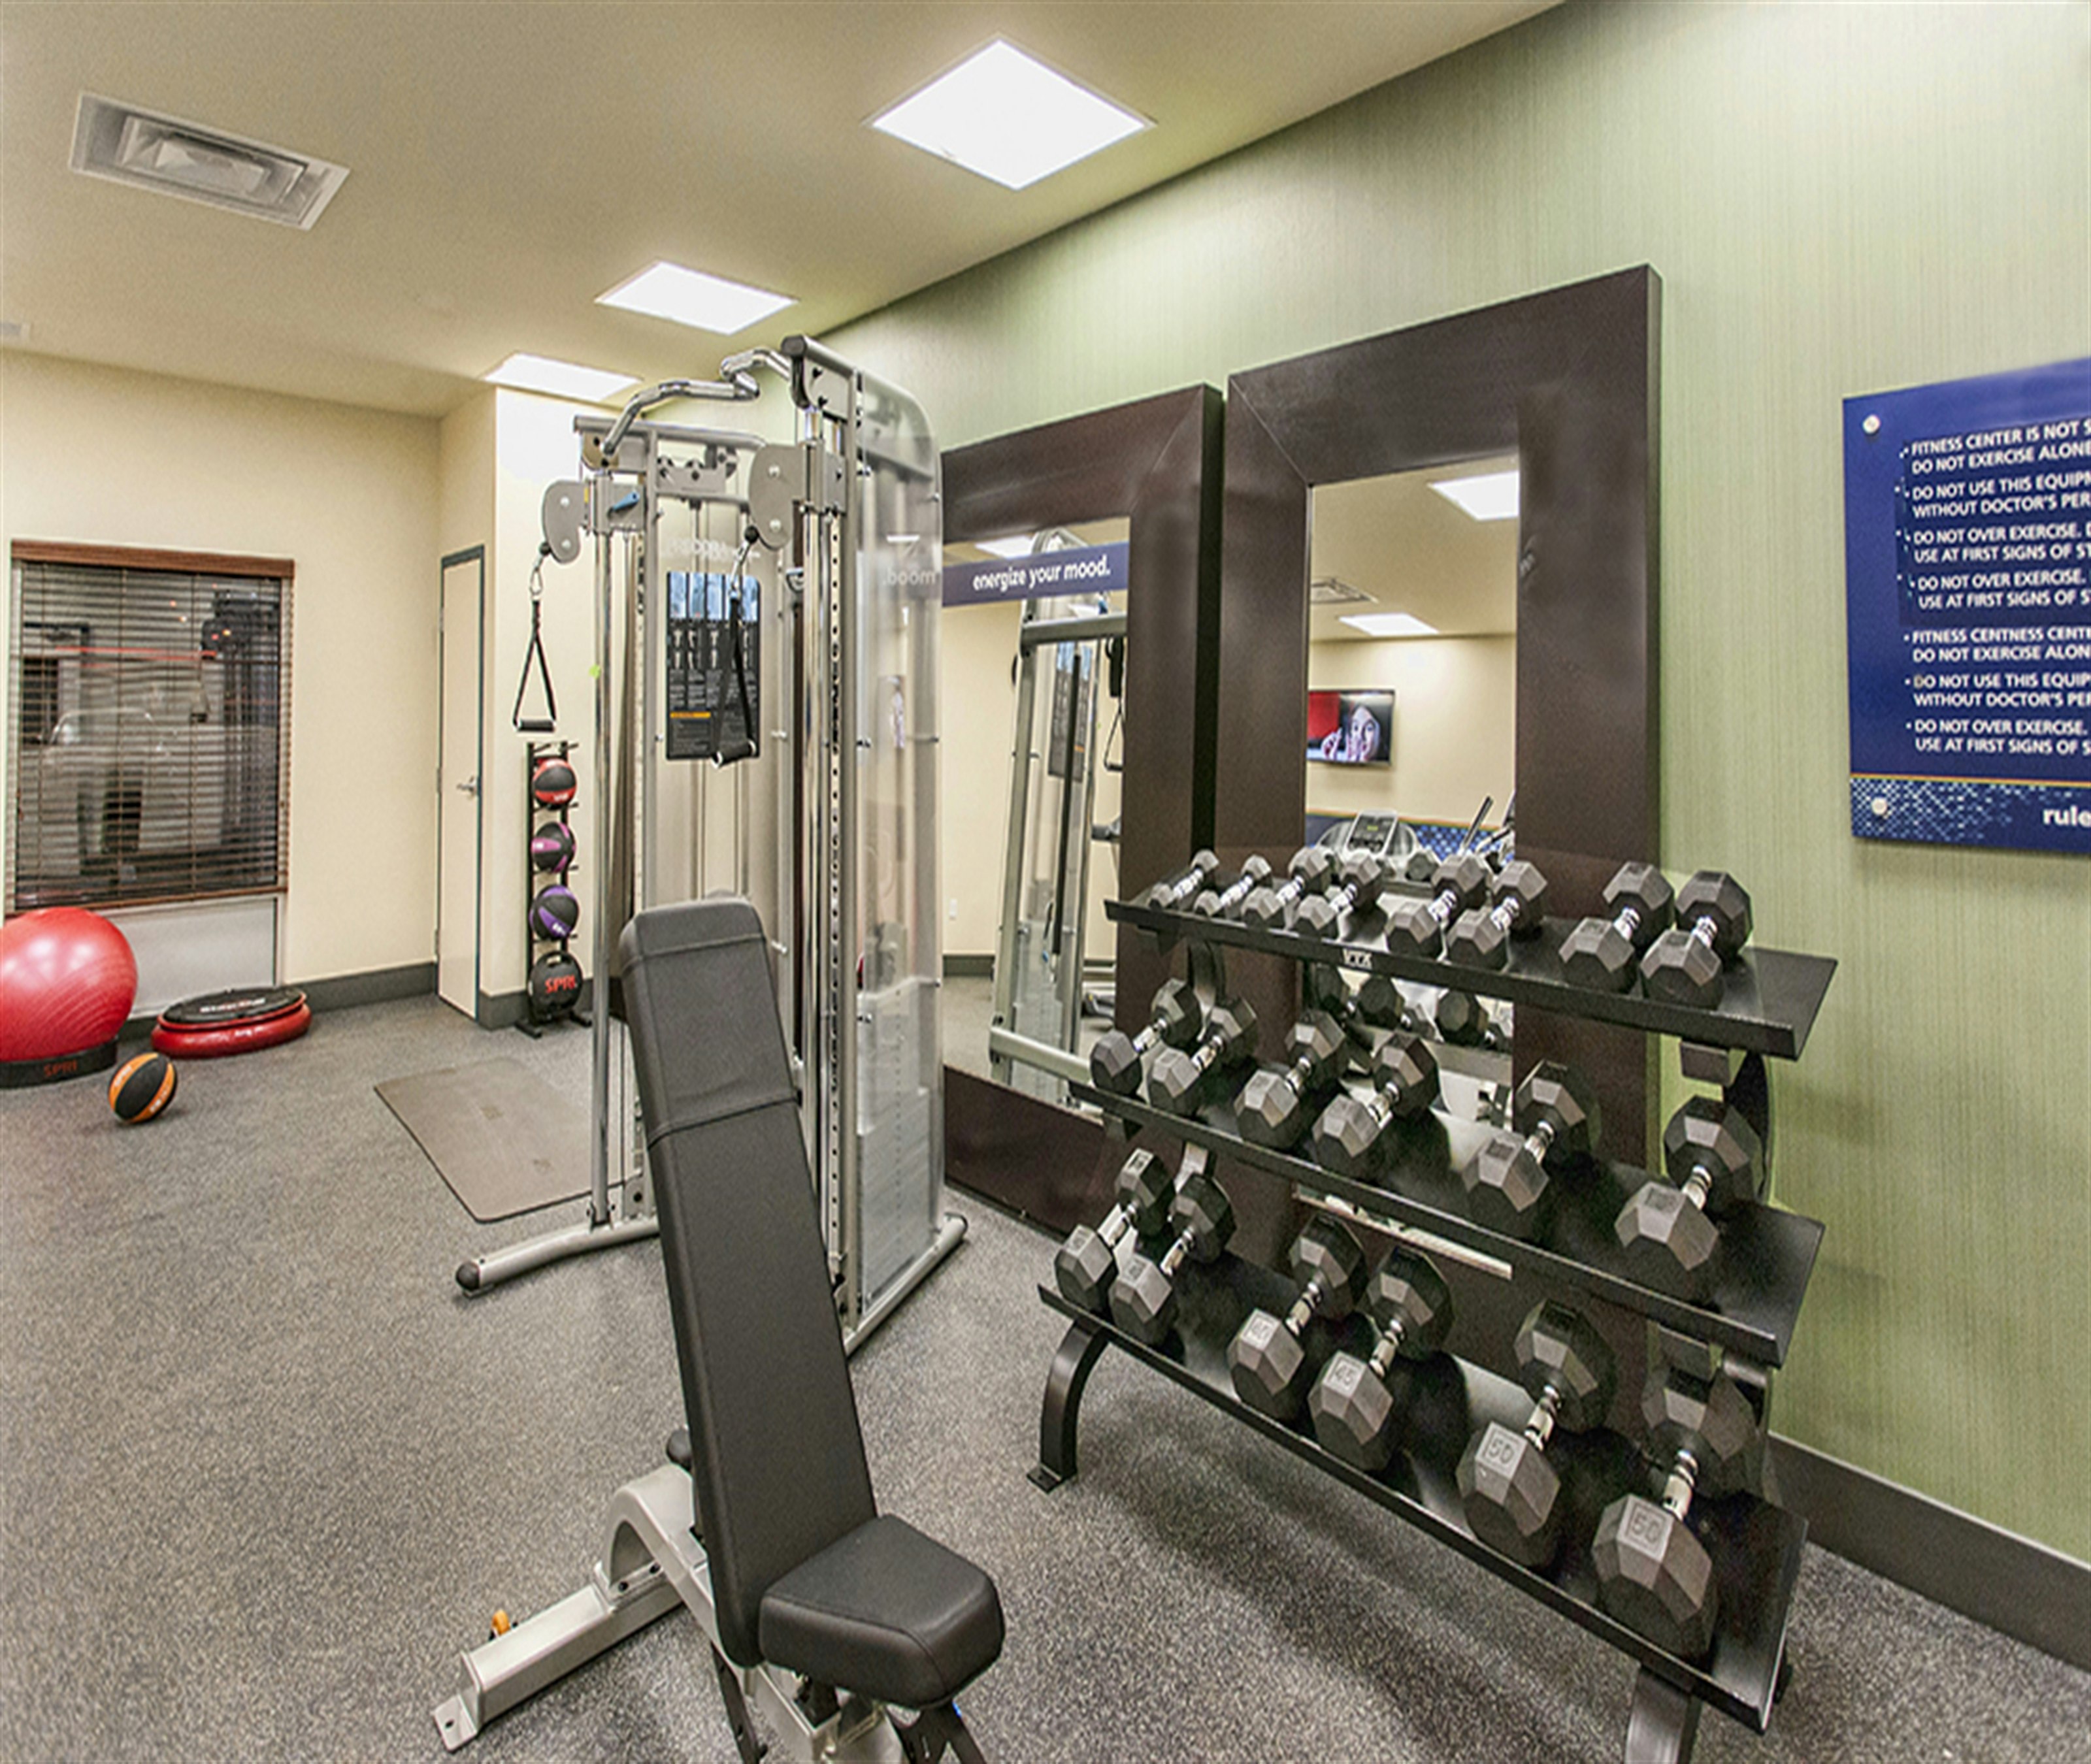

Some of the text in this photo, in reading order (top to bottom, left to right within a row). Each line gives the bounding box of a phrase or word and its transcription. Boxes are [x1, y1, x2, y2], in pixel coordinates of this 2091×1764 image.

[1912, 438, 1962, 456] FITNESS
[1966, 430, 2022, 448] CENTER
[2026, 427, 2039, 441] IS
[2044, 420, 2079, 439] NOT
[1912, 459, 1934, 474] DO
[1936, 455, 1965, 471] NOT
[1968, 448, 2033, 467] EXERCISE
[1913, 485, 1934, 500] DO
[1936, 482, 1966, 498] NOT
[1969, 479, 1994, 496] USE
[1999, 476, 2032, 492] THIS
[1913, 500, 1977, 518] WITHOUT
[1981, 495, 2058, 514] DOCTOR'S
[1913, 530, 1934, 545] DO
[1937, 529, 1965, 544] NOT
[1967, 527, 2006, 542] OVER
[2009, 523, 2081, 540] EXERCISE.
[1915, 548, 1938, 563] USE
[1941, 547, 1959, 561] AT
[1962, 546, 1999, 561] FIRST
[2002, 544, 2047, 561] SIGNS
[2050, 543, 2071, 559] OF
[973, 554, 1111, 592] energize your mood.
[1918, 568, 2086, 591] DO NOT OVER EXERCISE.
[1918, 595, 1942, 609] USE
[1946, 593, 1964, 608] AT
[1967, 592, 2003, 607] FIRST
[2007, 590, 2050, 606] SIGNS
[2054, 589, 2076, 606] OF
[1913, 629, 1967, 644] FITNESS
[1970, 627, 2044, 643] CENTNESS
[1913, 647, 1935, 662] DO
[1939, 647, 1969, 662] NOT
[1973, 645, 2041, 661] EXERCISE
[1913, 674, 1936, 689] DO
[1939, 674, 1969, 688] NOT
[1973, 674, 2000, 688] USE
[2005, 673, 2039, 687] THIS
[1913, 693, 1983, 707] WITHOUT
[1986, 692, 2064, 708] DOCTOR'S
[1915, 719, 2088, 735] DO NOT OVER EXERCISE.
[1915, 738, 1941, 751] USE
[1945, 738, 1964, 751] AT
[1967, 738, 2005, 753] FIRST
[2008, 738, 2053, 754] SIGNS
[2056, 739, 2077, 755] OF
[545, 975, 575, 994] SPRI
[43, 1060, 78, 1077] SPRI
[1489, 1438, 1515, 1465] 50
[1632, 1512, 1662, 1545] 50
